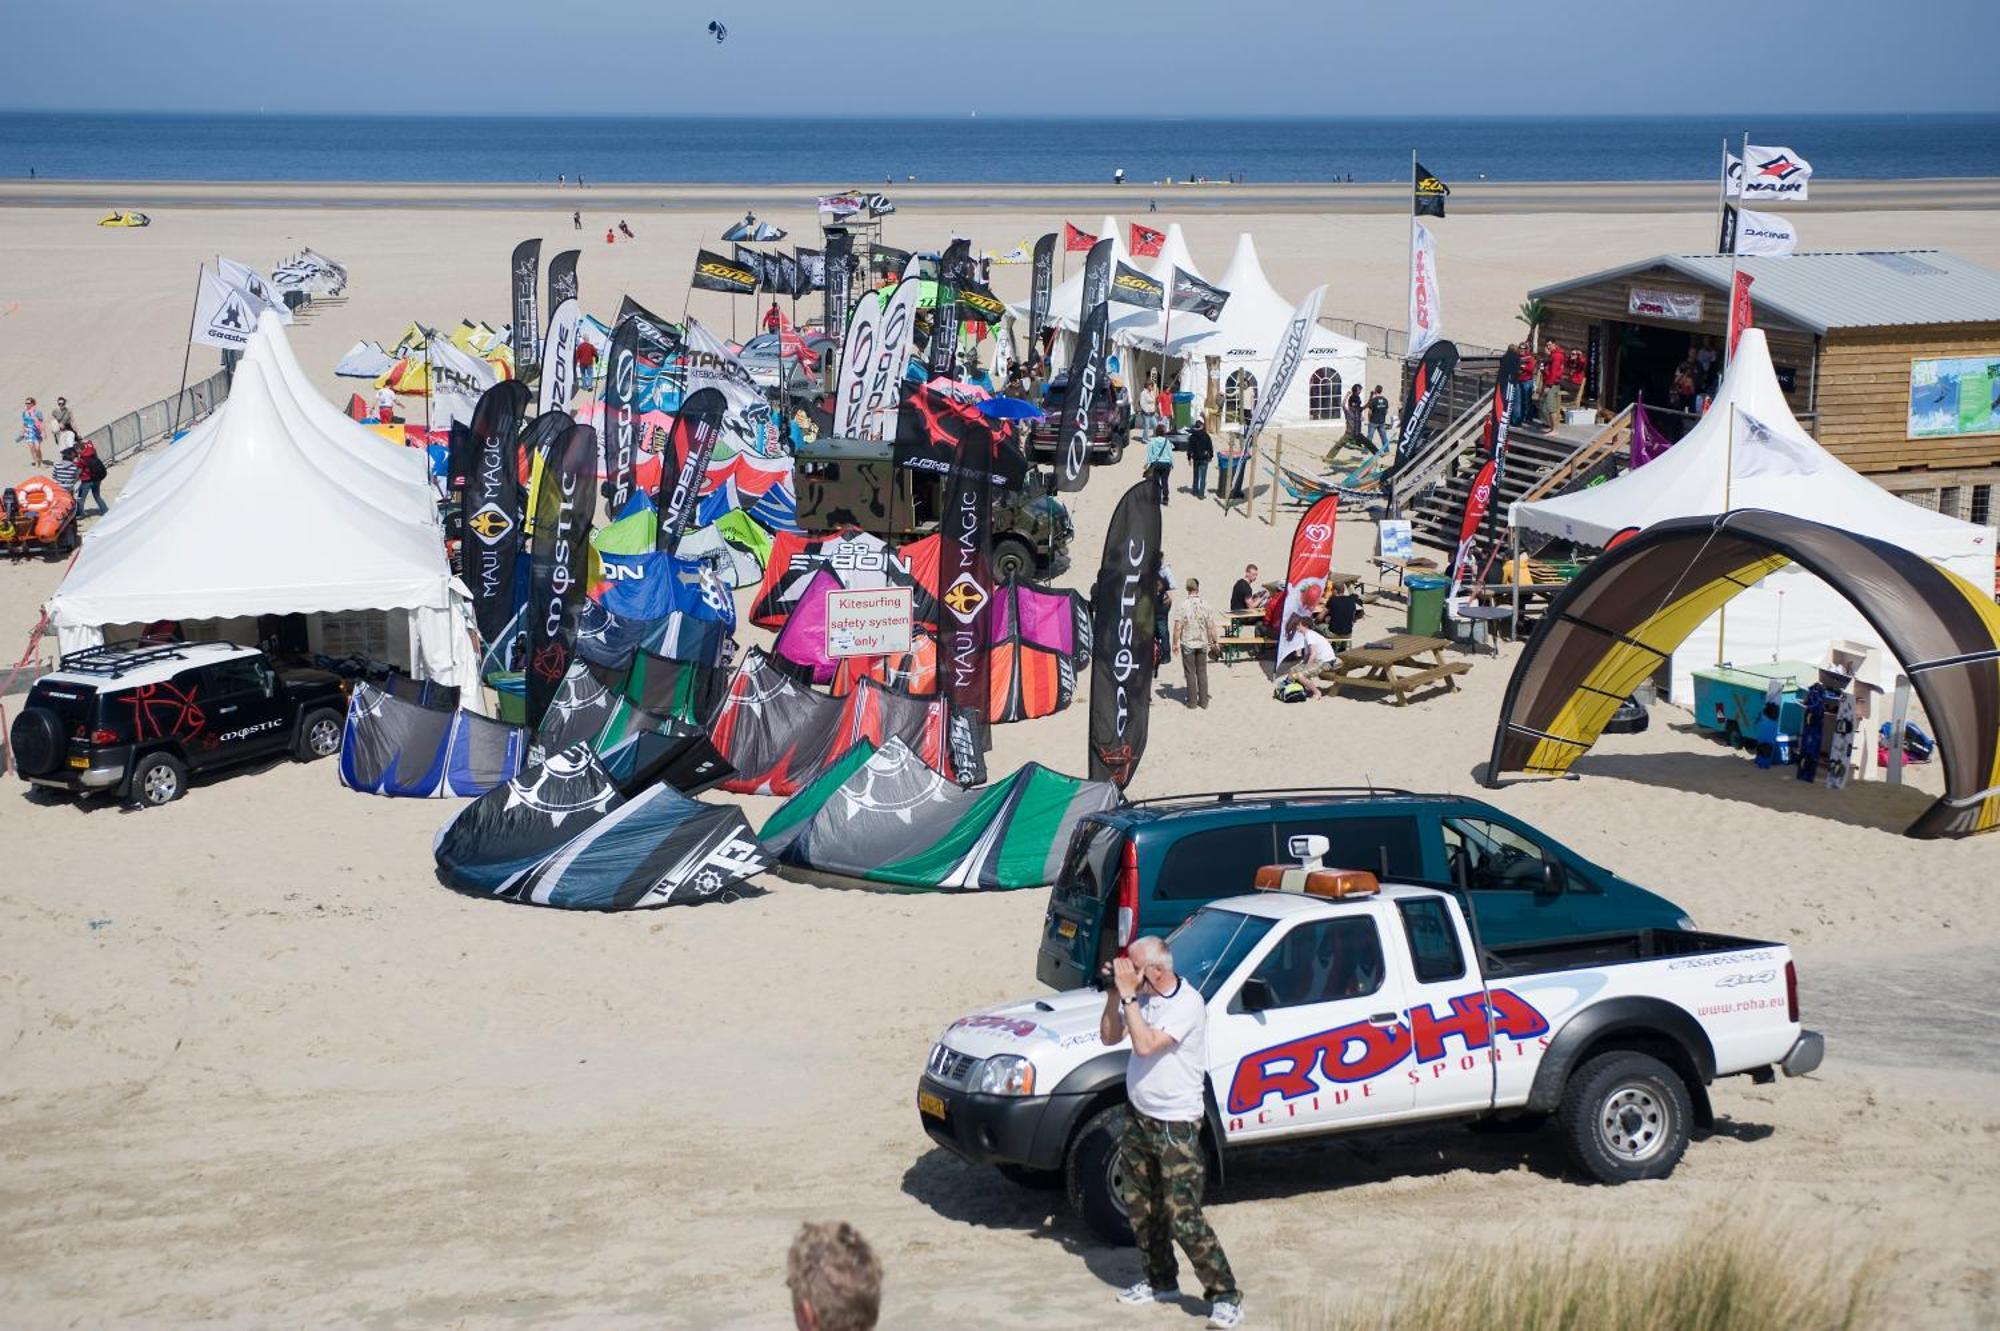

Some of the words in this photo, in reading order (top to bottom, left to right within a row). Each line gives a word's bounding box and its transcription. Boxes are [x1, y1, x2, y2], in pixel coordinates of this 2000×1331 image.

[1743, 228, 1791, 240] DAKINE
[483, 436, 503, 499] MAGIC
[661, 421, 711, 535] NOBILE
[958, 490, 977, 566] MAGIC
[480, 551, 501, 599] MAUI
[788, 553, 913, 575] NOBE
[831, 618, 867, 630] safety
[868, 616, 910, 628] system
[839, 597, 903, 609] Kitesurfing
[954, 630, 977, 688] MAUI
[1697, 997, 1785, 1017] www.roha.eu
[1227, 988, 1551, 1115] ROHA
[1407, 1034, 1552, 1085] SPORTS
